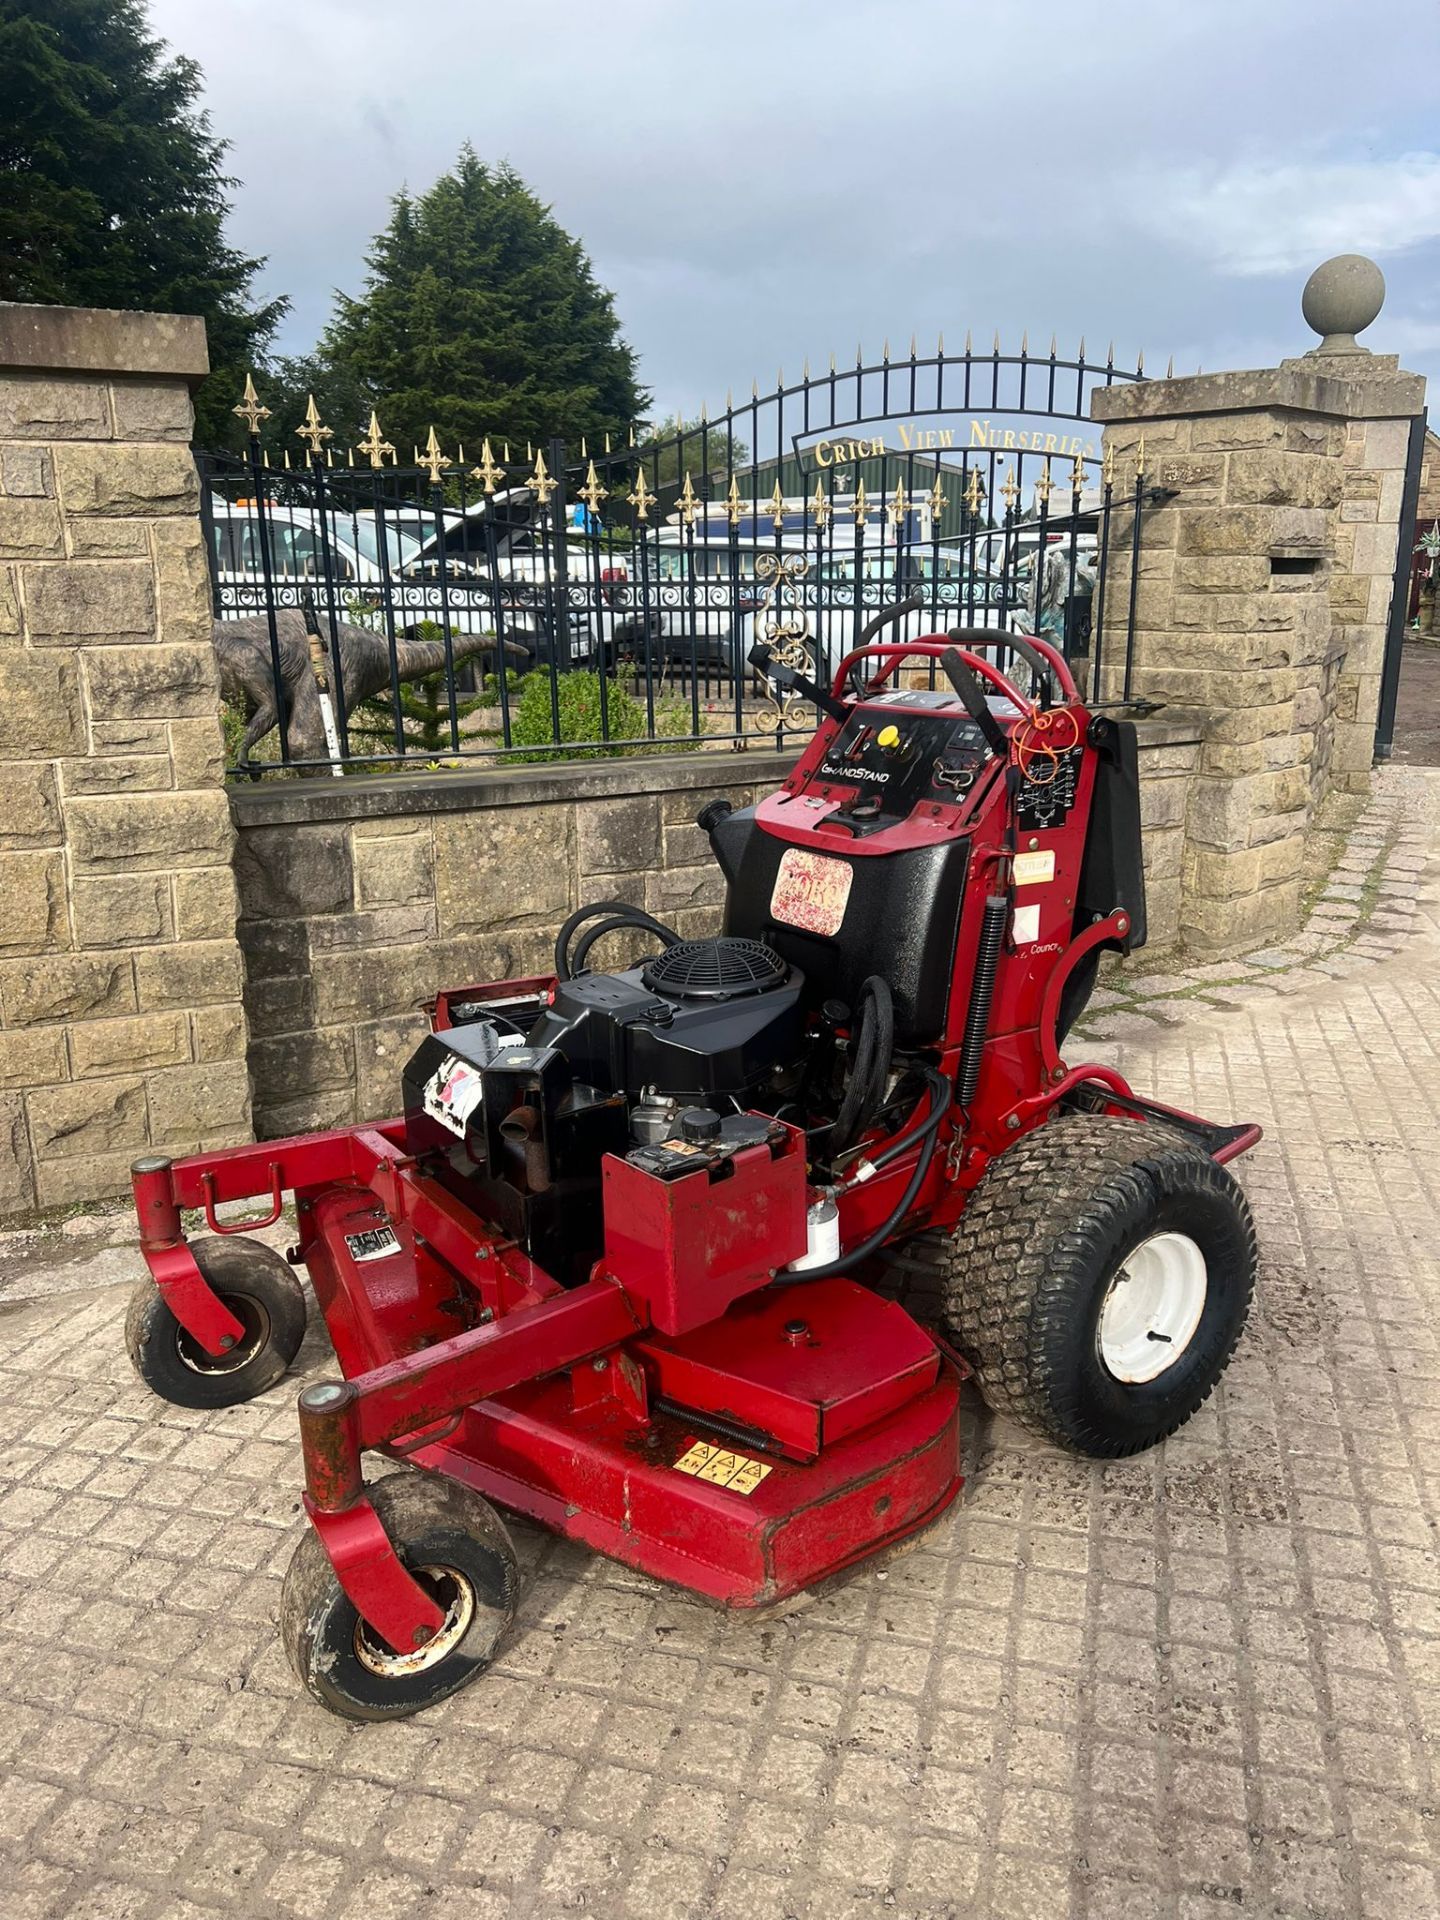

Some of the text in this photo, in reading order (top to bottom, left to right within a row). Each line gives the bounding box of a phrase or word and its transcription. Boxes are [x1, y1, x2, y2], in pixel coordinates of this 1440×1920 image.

[815, 420, 1095, 467] CRICH VIEW NURSERIES
